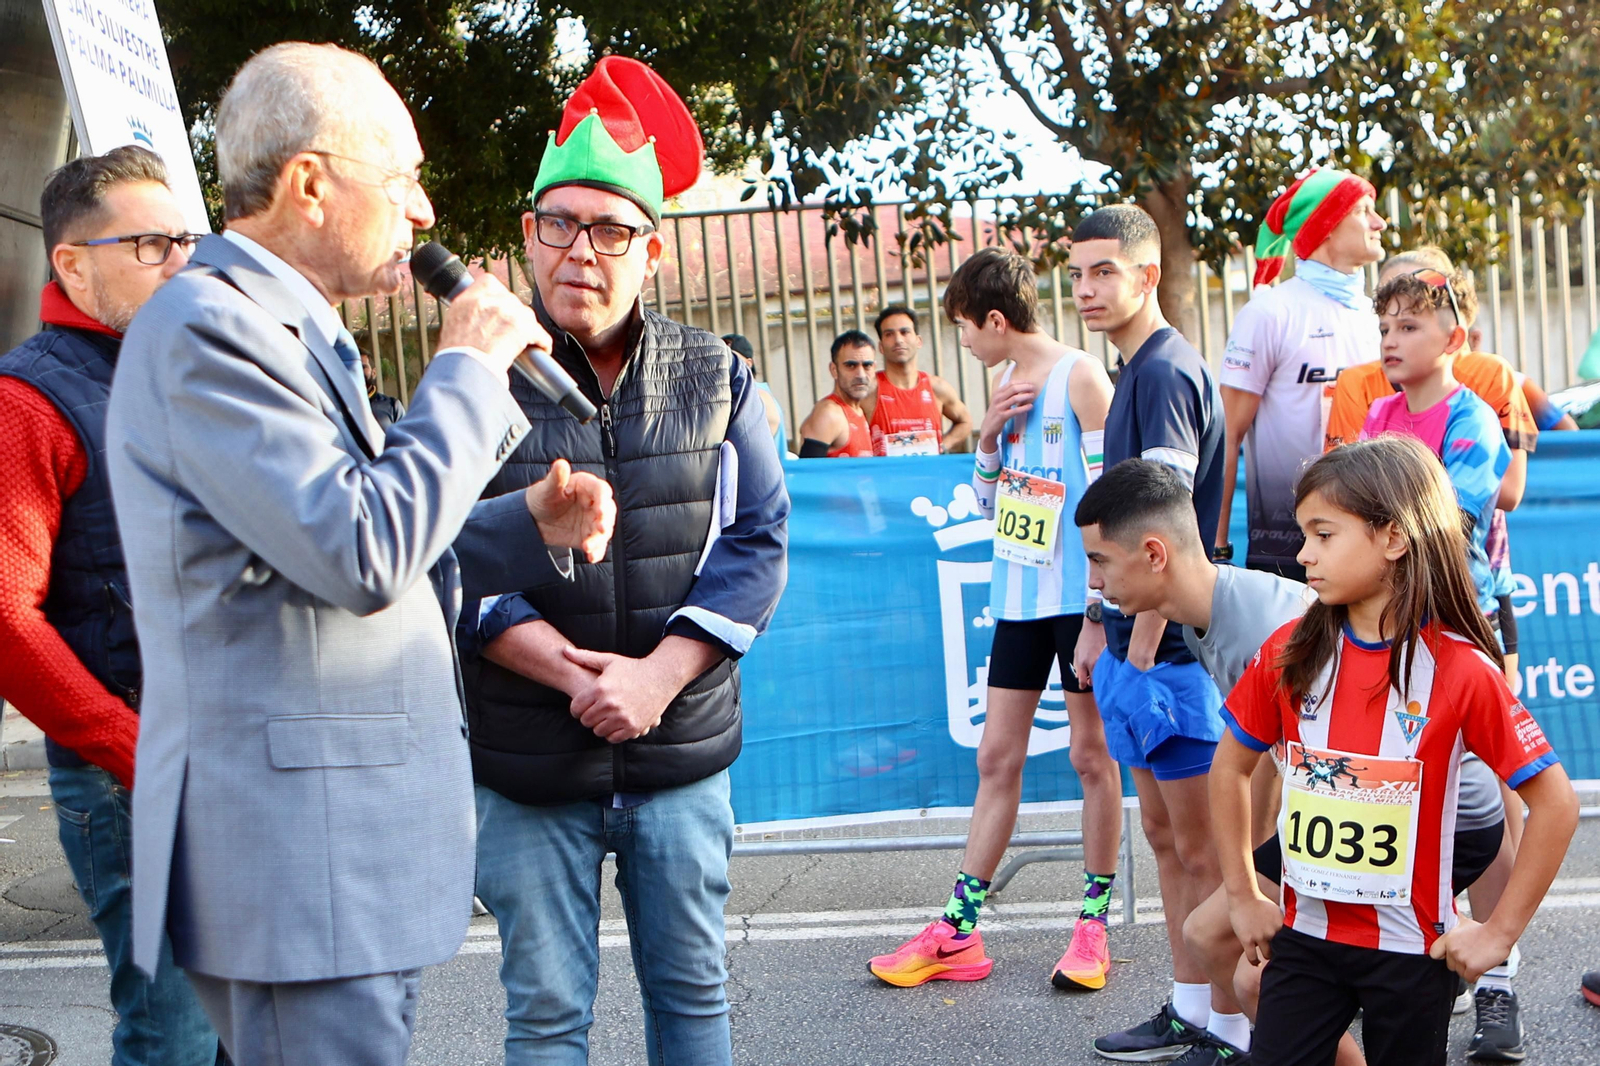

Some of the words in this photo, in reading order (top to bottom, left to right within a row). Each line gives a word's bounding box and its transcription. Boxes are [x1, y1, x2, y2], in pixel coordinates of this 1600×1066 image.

[97, 9, 160, 70] SILVESTRE
[68, 27, 118, 79] PALMA
[118, 60, 178, 115] PALMILLA
[997, 507, 1046, 546] 1031
[1377, 780, 1417, 791] XII
[1288, 810, 1398, 867] 1033
